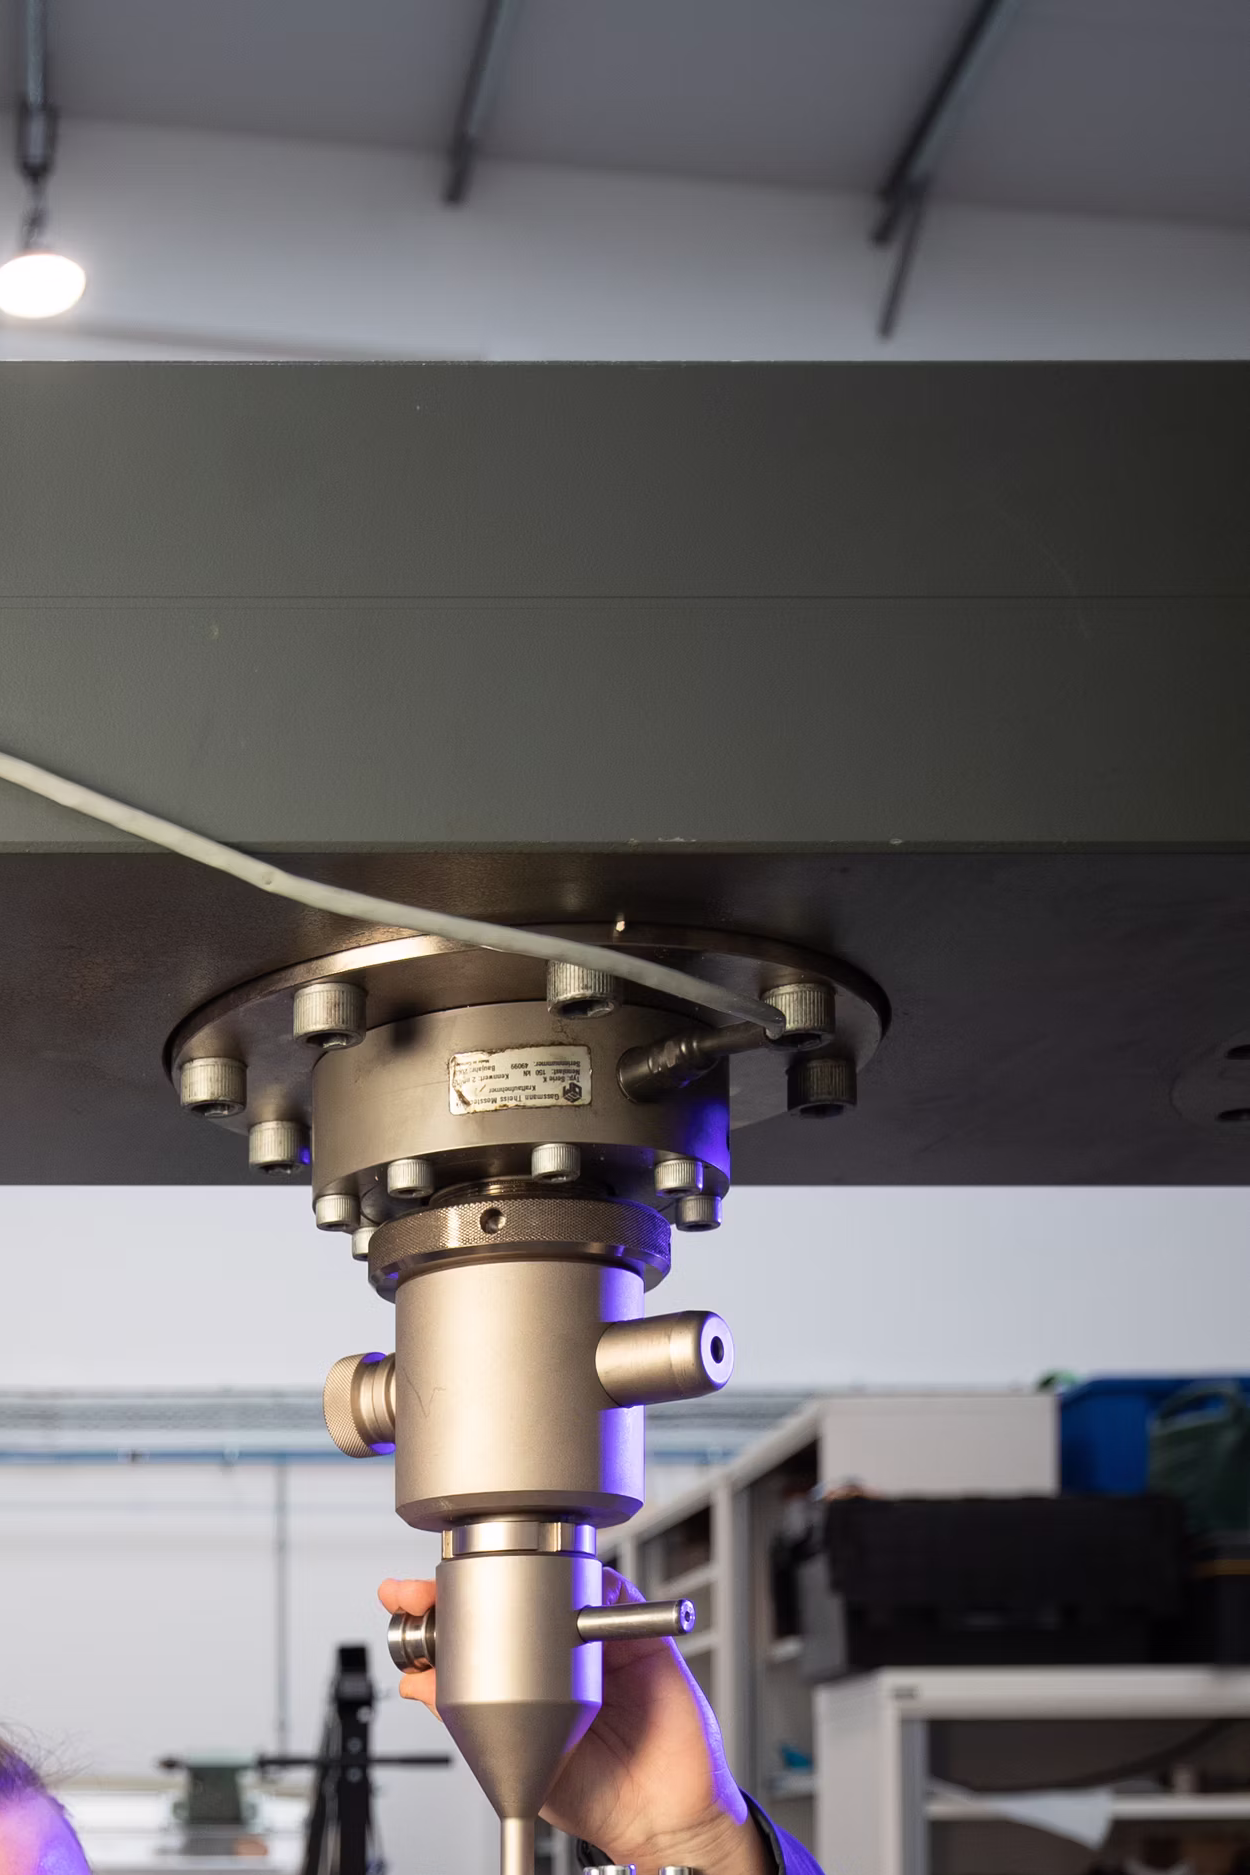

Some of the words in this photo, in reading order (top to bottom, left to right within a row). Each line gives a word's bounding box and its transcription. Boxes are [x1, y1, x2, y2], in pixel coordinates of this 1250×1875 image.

[489, 1084, 536, 1093] Kraftaufnehmer
[500, 1095, 522, 1103] Theiss
[525, 1093, 560, 1101] Gassmann
